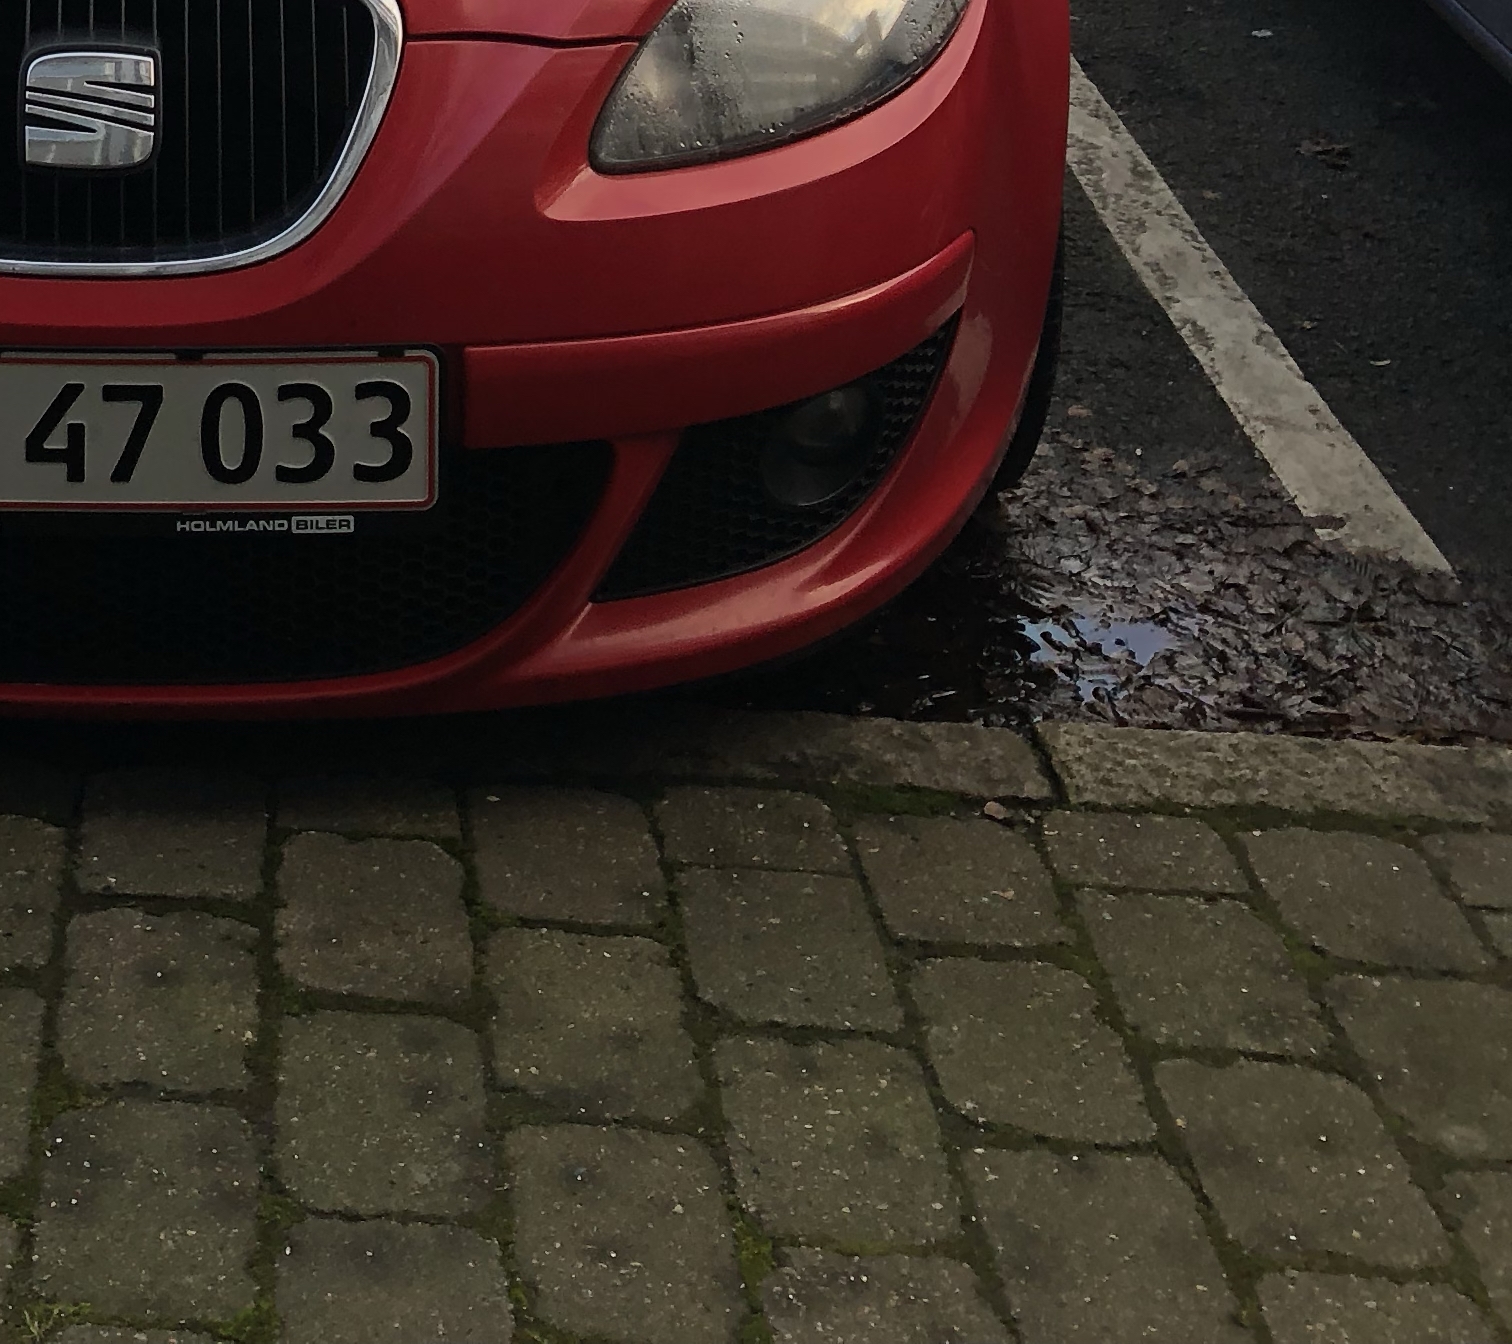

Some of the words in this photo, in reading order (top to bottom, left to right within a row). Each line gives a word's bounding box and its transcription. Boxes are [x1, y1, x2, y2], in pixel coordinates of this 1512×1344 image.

[25, 382, 164, 483] 47
[200, 380, 413, 485] 033
[176, 520, 288, 532] HOLMLAND
[294, 518, 352, 531] BILER
